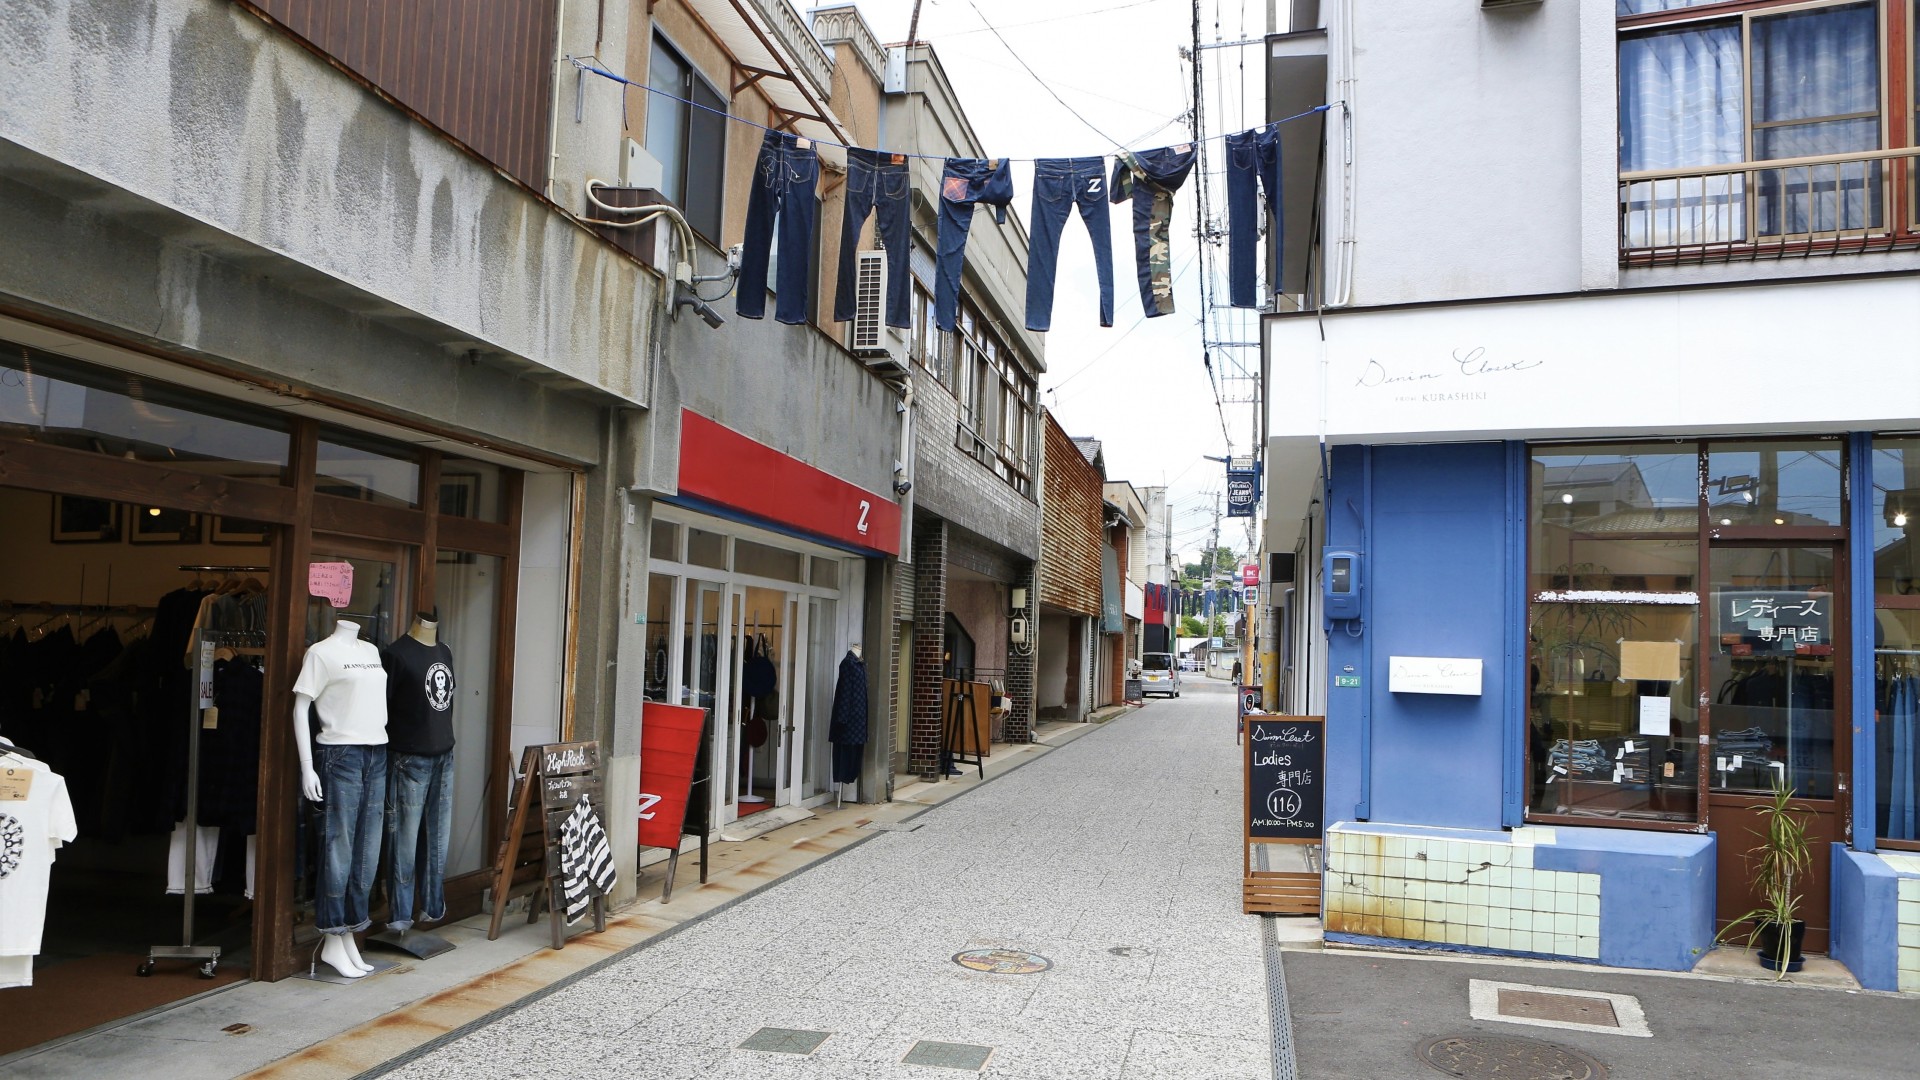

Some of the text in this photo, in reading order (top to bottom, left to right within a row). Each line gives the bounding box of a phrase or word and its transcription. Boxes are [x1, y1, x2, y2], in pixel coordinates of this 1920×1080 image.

[1087, 178, 1102, 193] Z
[1355, 346, 1544, 388] Denim Closet
[1422, 391, 1488, 403] KURASHIKI
[1230, 495, 1251, 503] STREET
[857, 499, 870, 532] Z
[1731, 596, 1823, 619] レディース
[1757, 625, 1820, 642] 専門店
[201, 681, 213, 699] SALE
[1341, 678, 1358, 686] 9-21
[1254, 750, 1292, 767] Ladies
[1276, 768, 1312, 788] 専門店
[1272, 794, 1296, 813] 116
